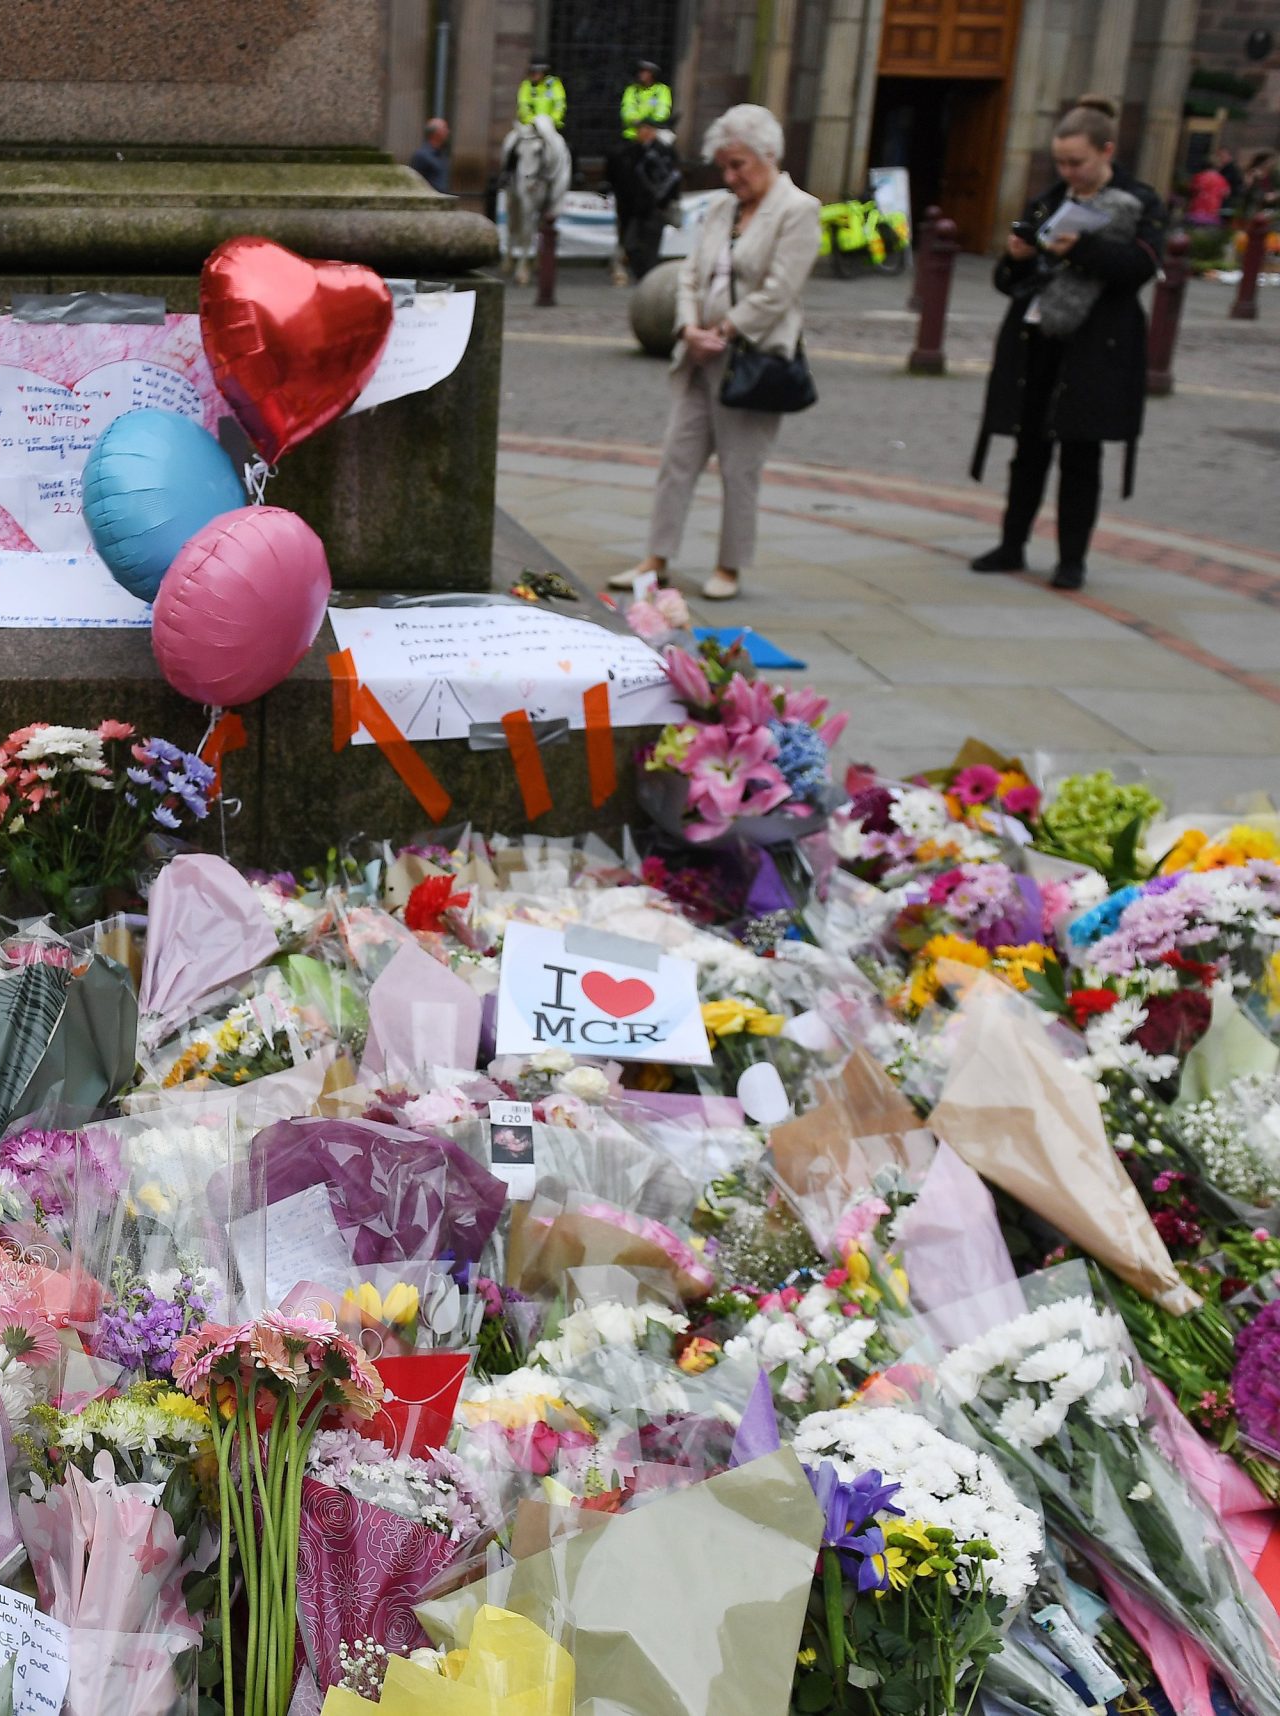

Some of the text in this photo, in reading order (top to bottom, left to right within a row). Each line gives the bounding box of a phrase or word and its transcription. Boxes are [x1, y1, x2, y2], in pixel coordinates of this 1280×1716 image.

[35, 412, 82, 430] UNITED
[541, 964, 577, 1012] I
[532, 1011, 666, 1045] MCR
[501, 1114, 523, 1124] £20
[13, 1598, 35, 1618] STAY
[29, 1658, 51, 1674] OUR
